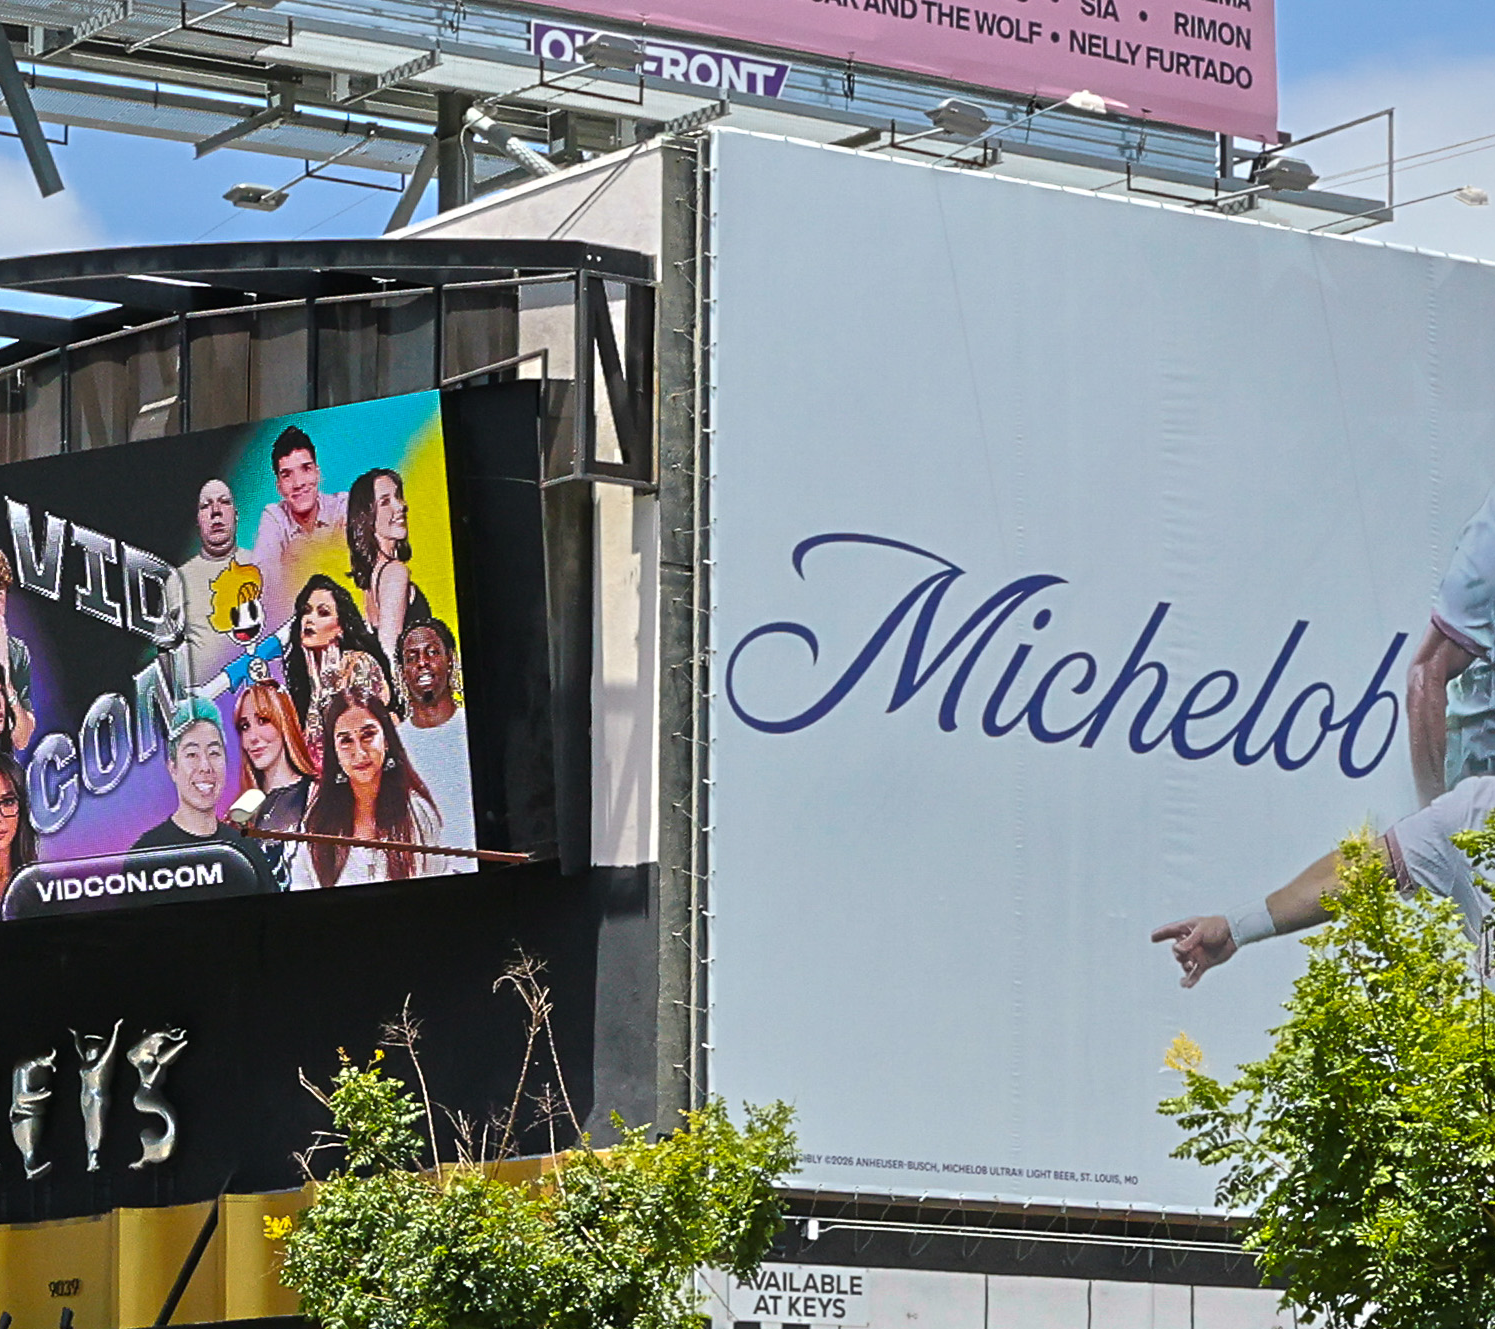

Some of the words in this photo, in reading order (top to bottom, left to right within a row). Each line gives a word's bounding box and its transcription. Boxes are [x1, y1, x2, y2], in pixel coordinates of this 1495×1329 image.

[921, 0, 970, 32] THE
[975, 10, 1042, 44] WOLF
[1069, 29, 1142, 67] NELLY
[1146, 46, 1253, 91] FURTADO
[1174, 13, 1251, 52] RIMON
[540, 29, 775, 96] OFRONT
[4, 494, 192, 651] VID
[726, 533, 1409, 779] Michelob
[36, 862, 223, 903] VIDCON.COM
[856, 1157, 940, 1172] ANHEUSER-BUSCH,
[942, 1163, 988, 1175] MICHELOB
[1026, 1169, 1052, 1179] LIGHT
[1053, 1171, 1078, 1182] BEER,
[1094, 1174, 1122, 1185] LOUIS,
[1124, 1175, 1138, 1185] MO
[735, 1271, 863, 1297] AVAILABLE
[753, 1295, 783, 1317] AT
[787, 1295, 847, 1319] KEYS
